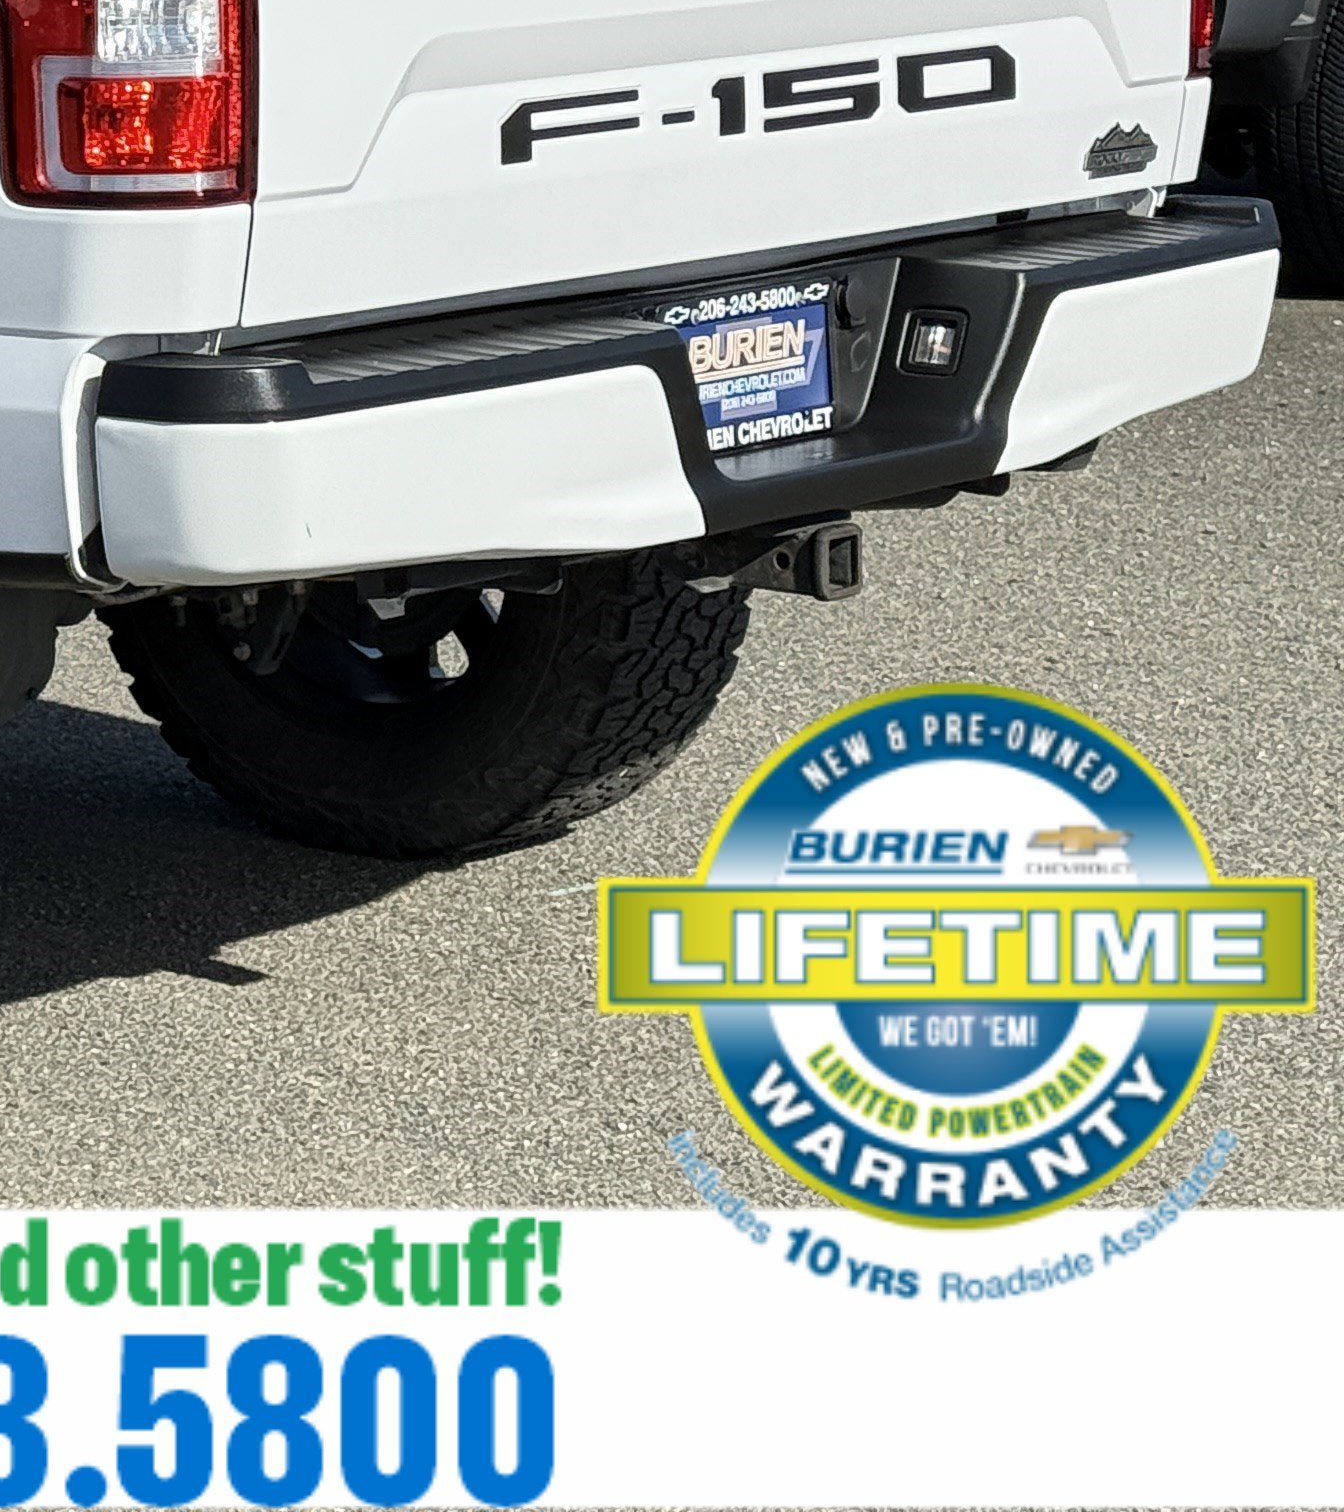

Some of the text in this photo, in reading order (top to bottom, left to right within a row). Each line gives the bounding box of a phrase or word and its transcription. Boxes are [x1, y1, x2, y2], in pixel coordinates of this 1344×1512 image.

[499, 44, 1017, 166] F-150
[698, 285, 796, 322] 206-243-5800
[689, 319, 805, 373] BURIEN
[737, 406, 833, 445] CHEVROLET
